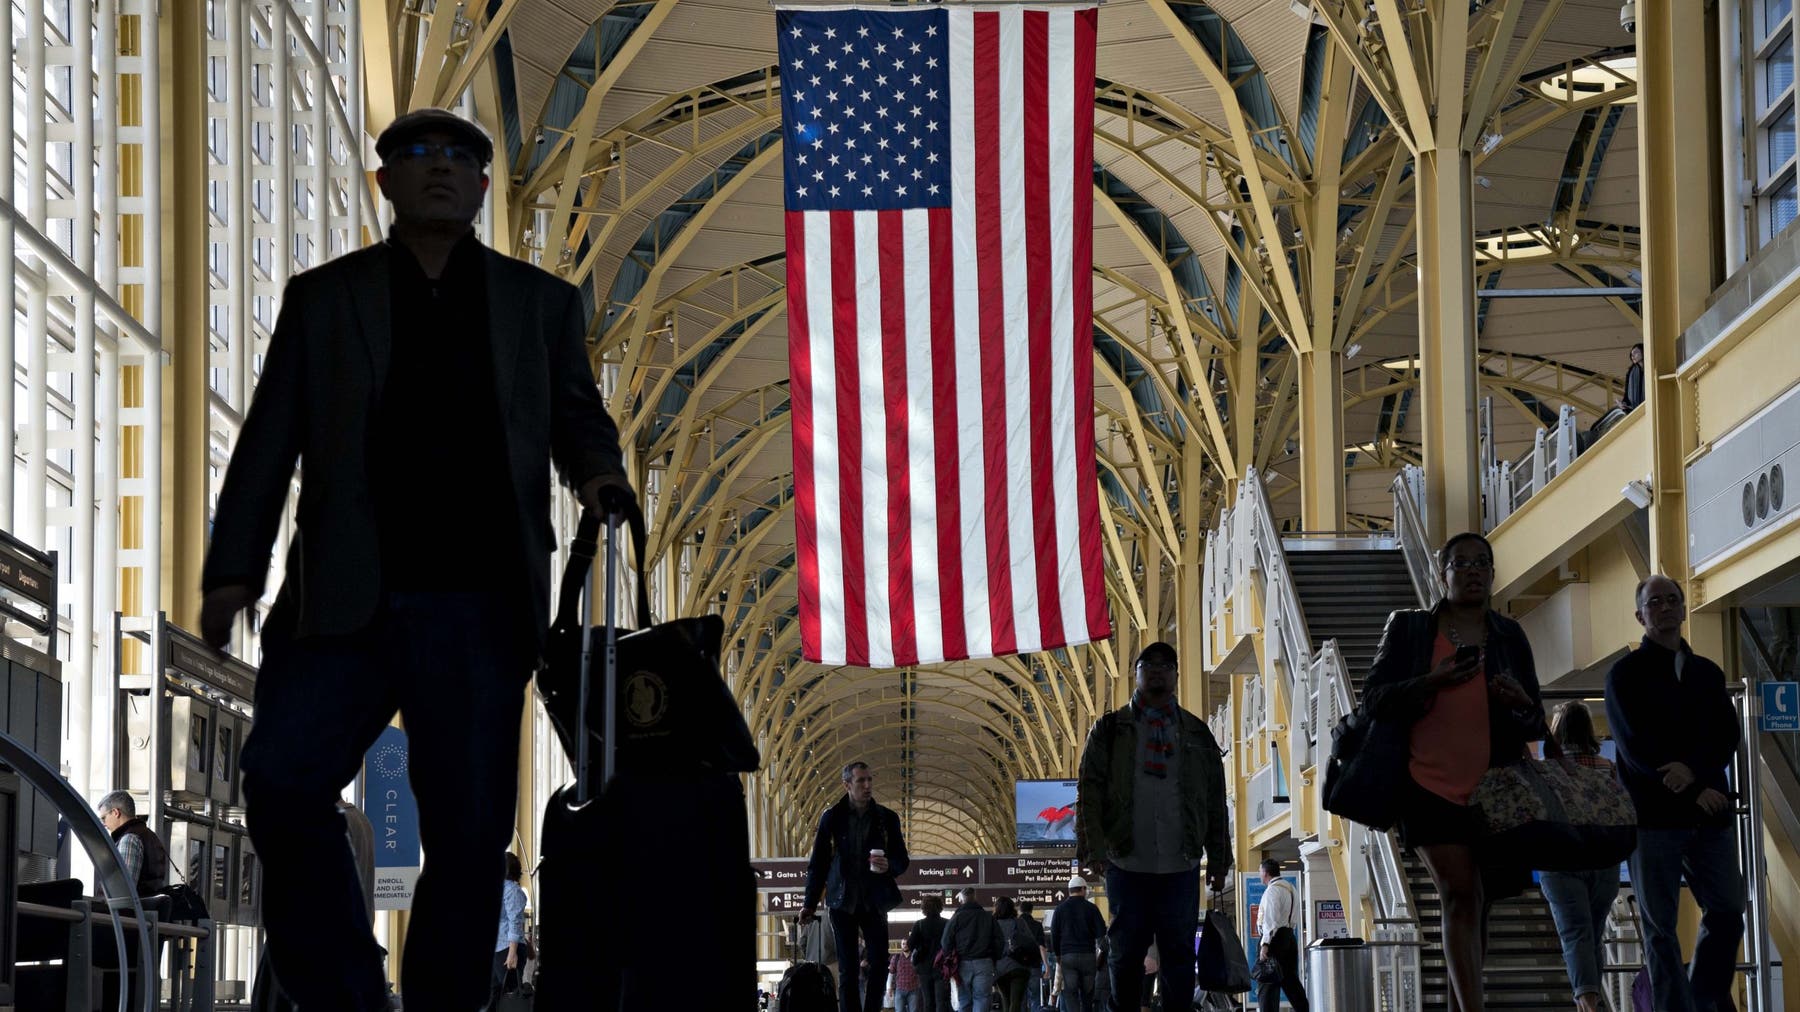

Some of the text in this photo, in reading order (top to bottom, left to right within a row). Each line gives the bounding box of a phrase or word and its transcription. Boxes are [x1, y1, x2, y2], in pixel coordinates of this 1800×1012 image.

[1771, 721, 1792, 729] Phone
[386, 790, 398, 849] CLEAR
[919, 868, 944, 877] Parking
[919, 889, 943, 897] Terminal
